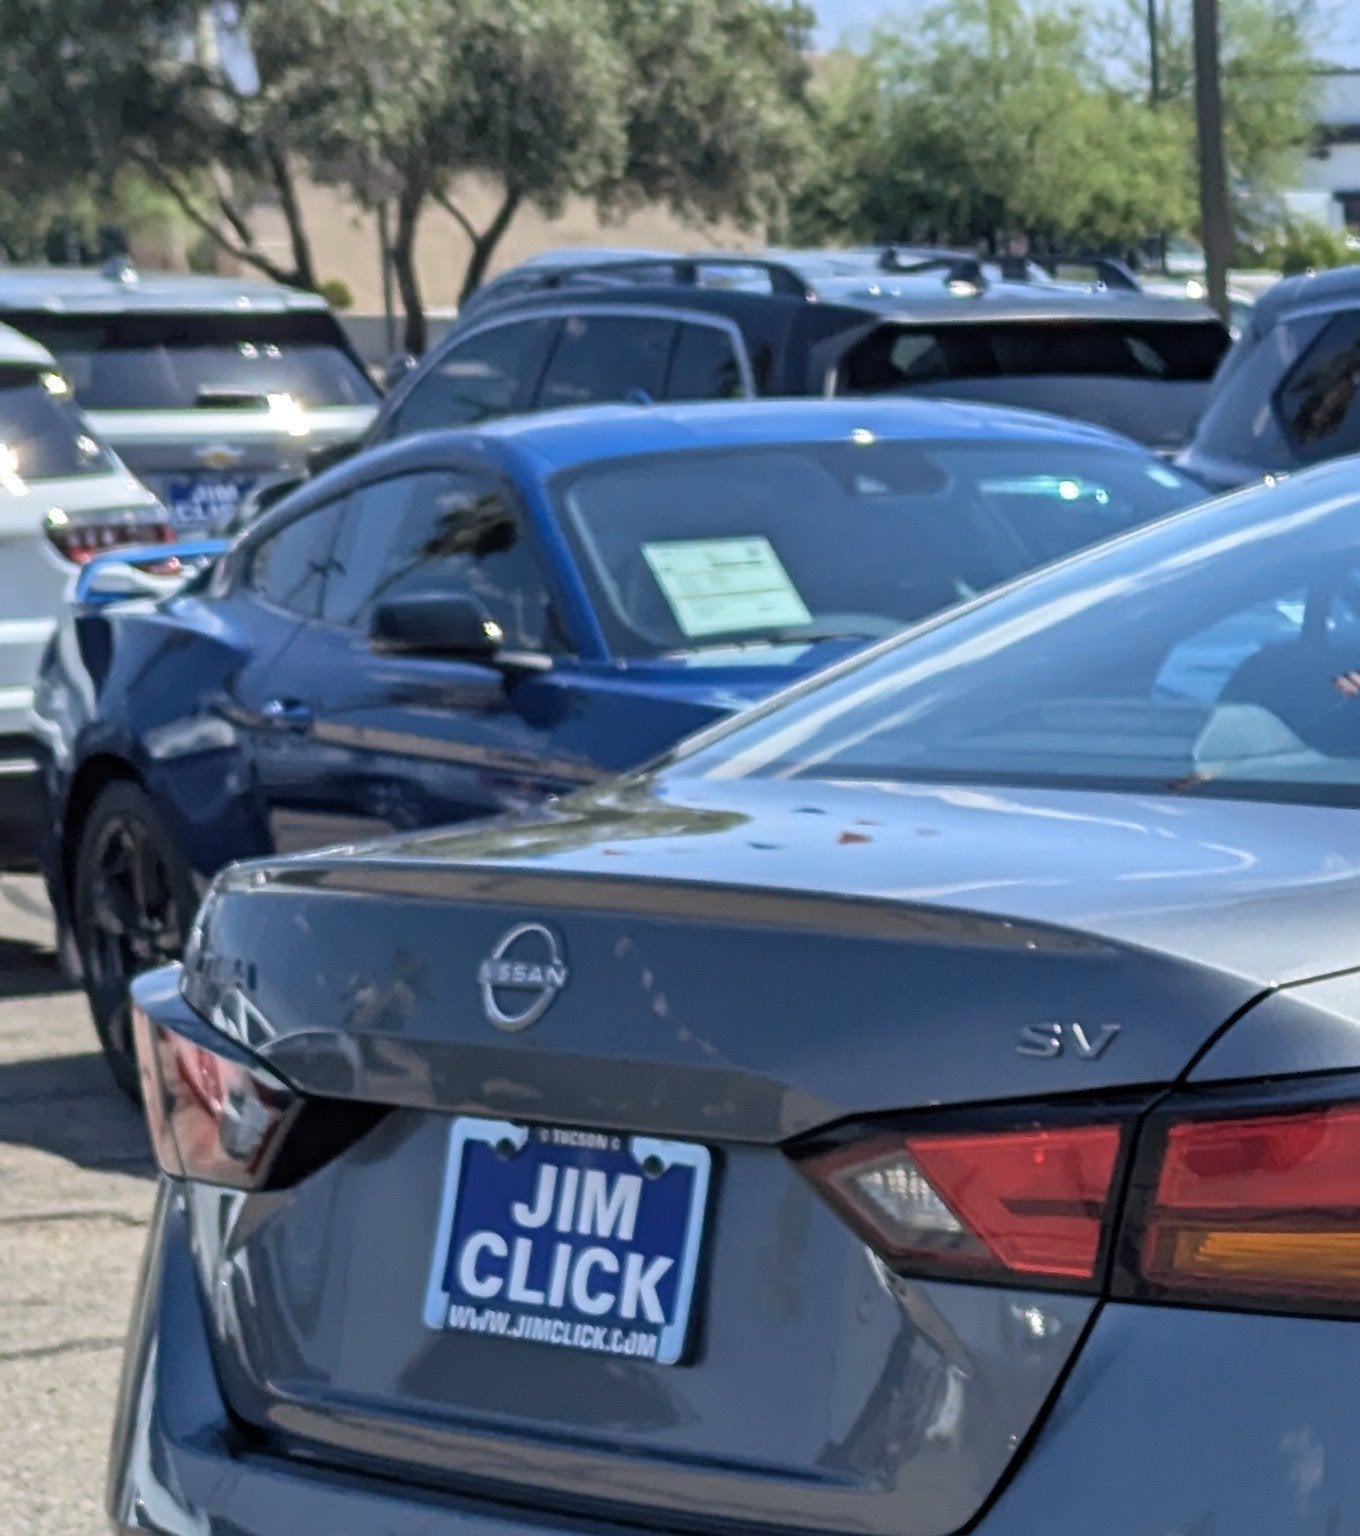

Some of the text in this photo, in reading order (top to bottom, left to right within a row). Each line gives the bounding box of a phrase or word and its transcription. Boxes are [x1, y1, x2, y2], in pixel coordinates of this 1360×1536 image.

[478, 959, 569, 986] NISSAN
[1016, 1022, 1121, 1058] SV
[553, 1128, 608, 1150] TUCSON
[512, 1163, 643, 1240] JIM
[459, 1231, 675, 1324] CLICK
[449, 1304, 658, 1359] WWW.JIMCLICK.COM
